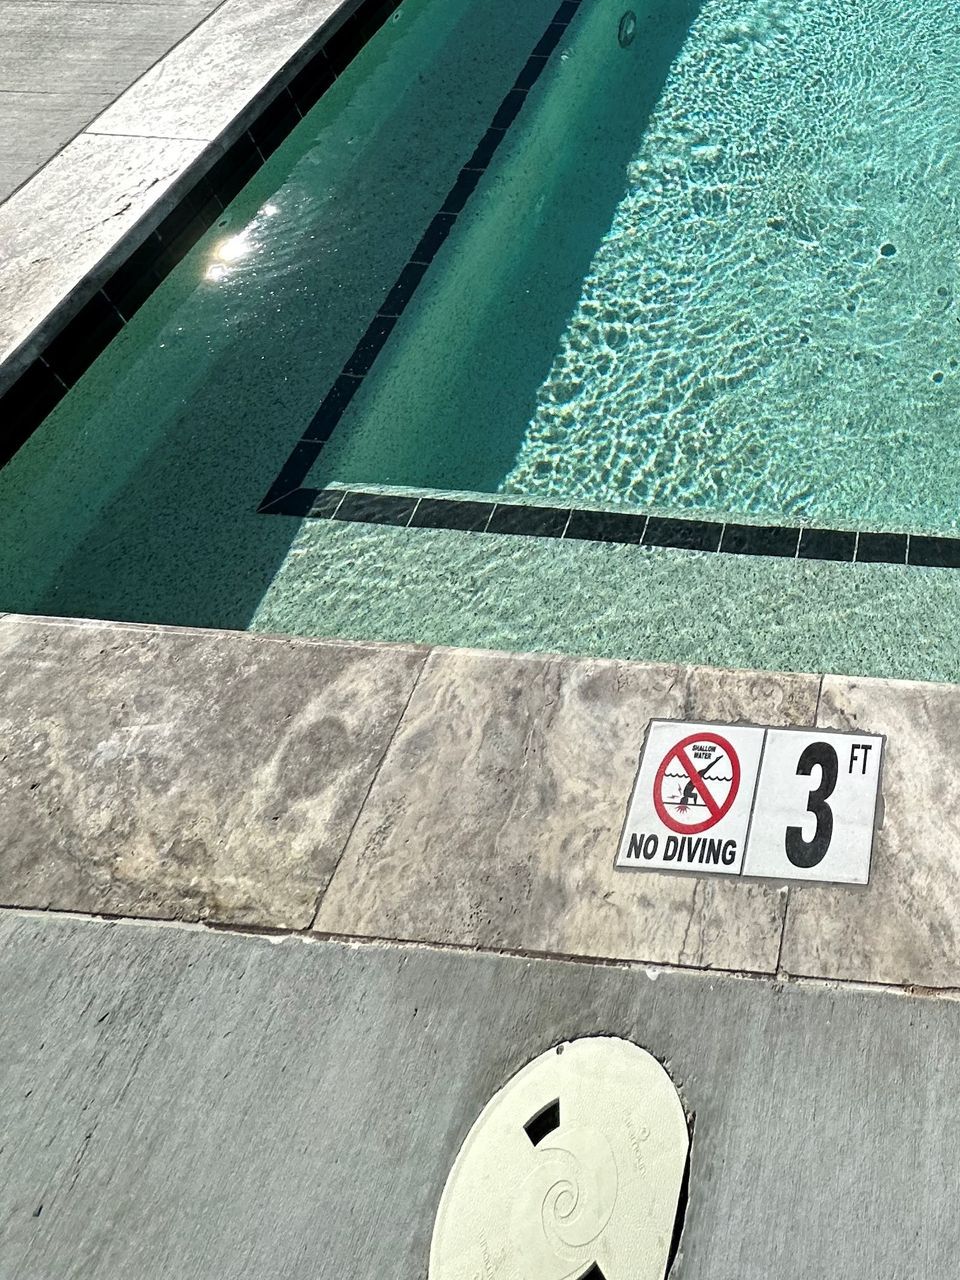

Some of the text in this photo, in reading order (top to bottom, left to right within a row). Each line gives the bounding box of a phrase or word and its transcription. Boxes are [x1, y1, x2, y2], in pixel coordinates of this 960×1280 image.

[692, 744, 717, 753] SHALLOW
[693, 751, 712, 760] WATER
[785, 741, 872, 869] 3 FT
[626, 832, 737, 866] NO DIVING
